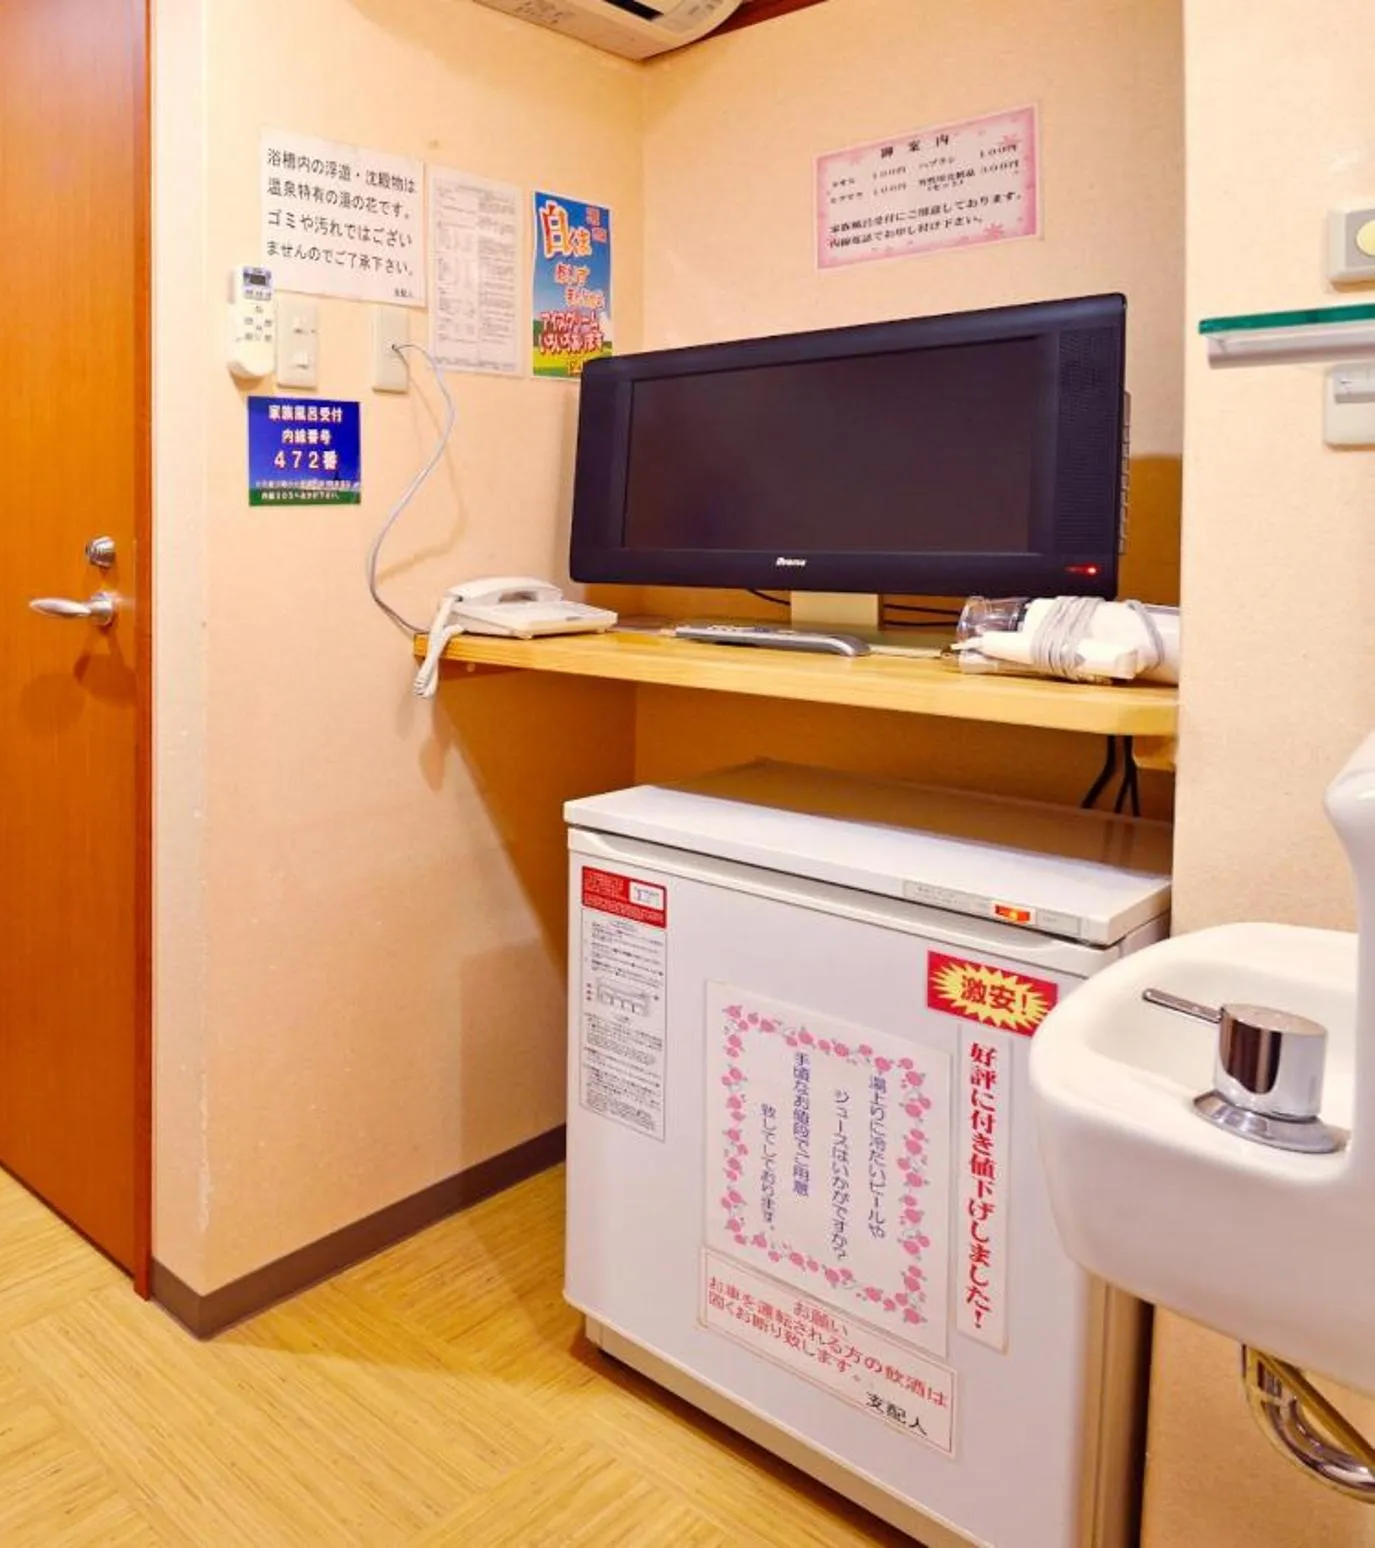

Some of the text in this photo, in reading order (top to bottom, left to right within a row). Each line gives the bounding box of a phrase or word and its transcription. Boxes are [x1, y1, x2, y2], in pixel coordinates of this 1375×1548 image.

[267, 148, 417, 193] 浴槽内の浮遊・沈殿物は
[267, 178, 410, 219] 温泉特有の湯の花です。
[268, 209, 412, 247] ゴミや汚れではござい
[267, 241, 413, 276] ませんのでご了承下さい。
[708, 1290, 862, 1382] 固くお断り致します。
[793, 1300, 848, 1337] お願い
[708, 1276, 948, 1408] お車を運転される方の飲酒は
[865, 1391, 928, 1437] 支配人
